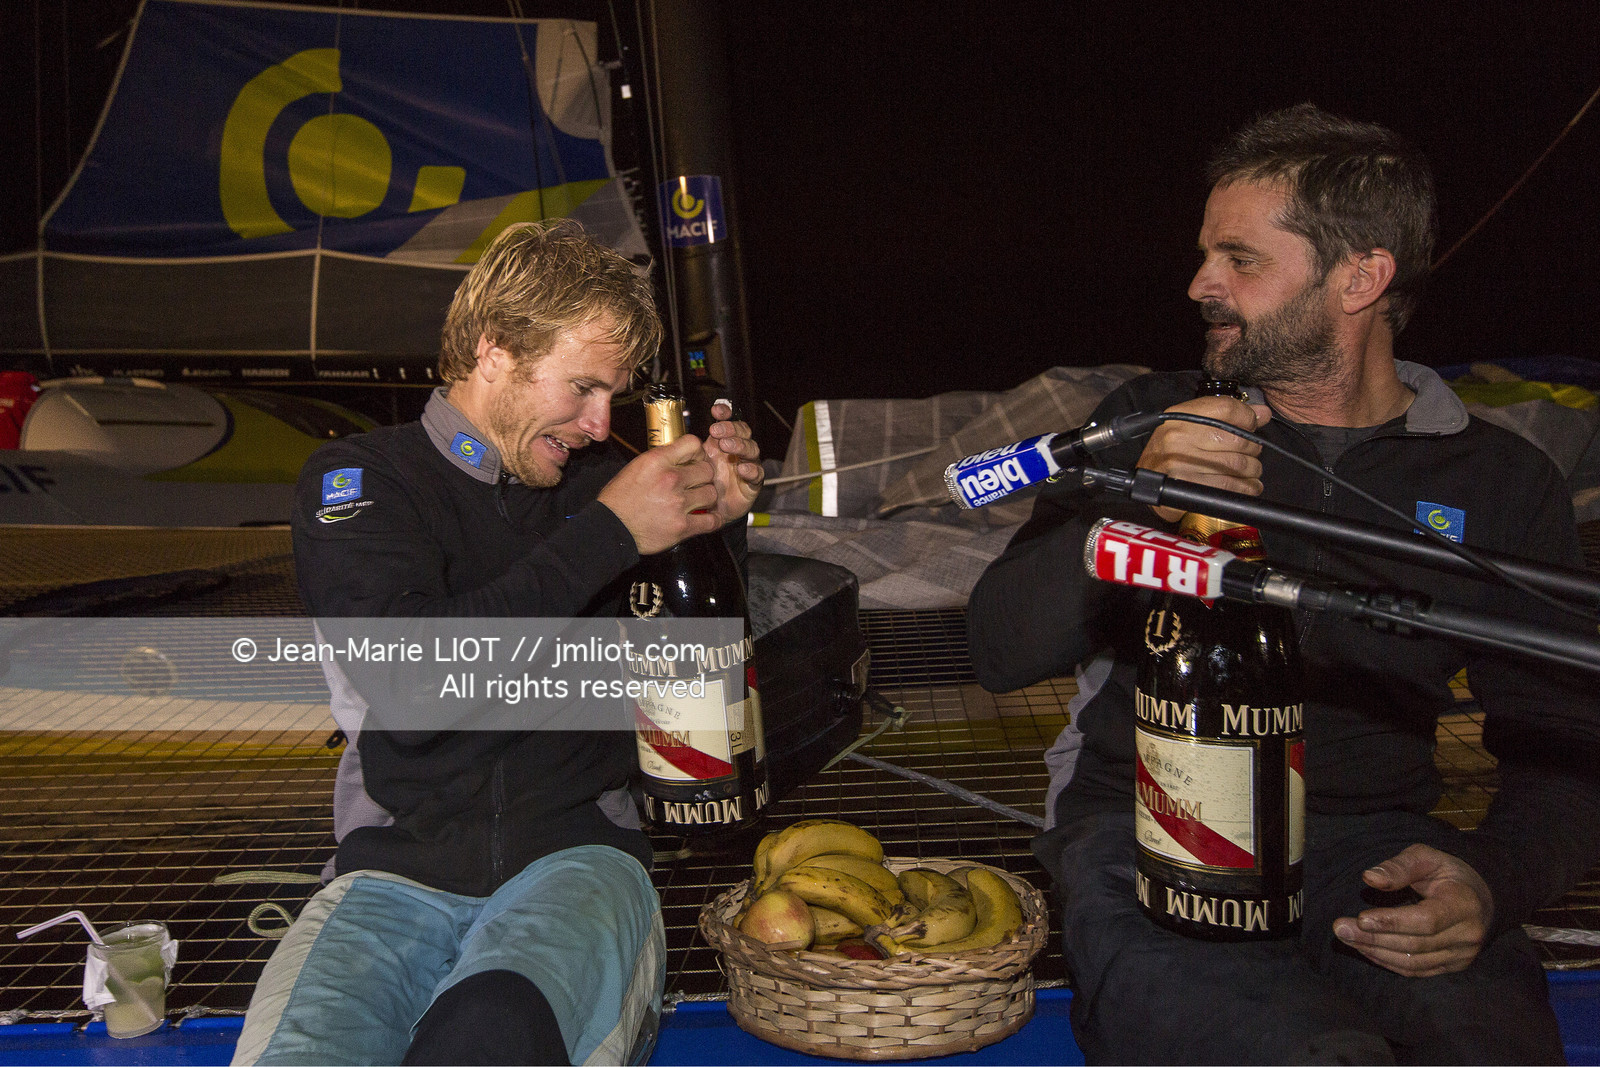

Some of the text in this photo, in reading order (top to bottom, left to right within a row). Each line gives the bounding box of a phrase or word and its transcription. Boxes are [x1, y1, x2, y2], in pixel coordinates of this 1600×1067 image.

[960, 457, 1031, 500] bleu
[1105, 539, 1199, 595] RTL
[695, 634, 754, 675] MUMM
[1221, 703, 1303, 736] MUMM
[663, 796, 743, 825] MUMM
[1165, 886, 1270, 932] MUMM
